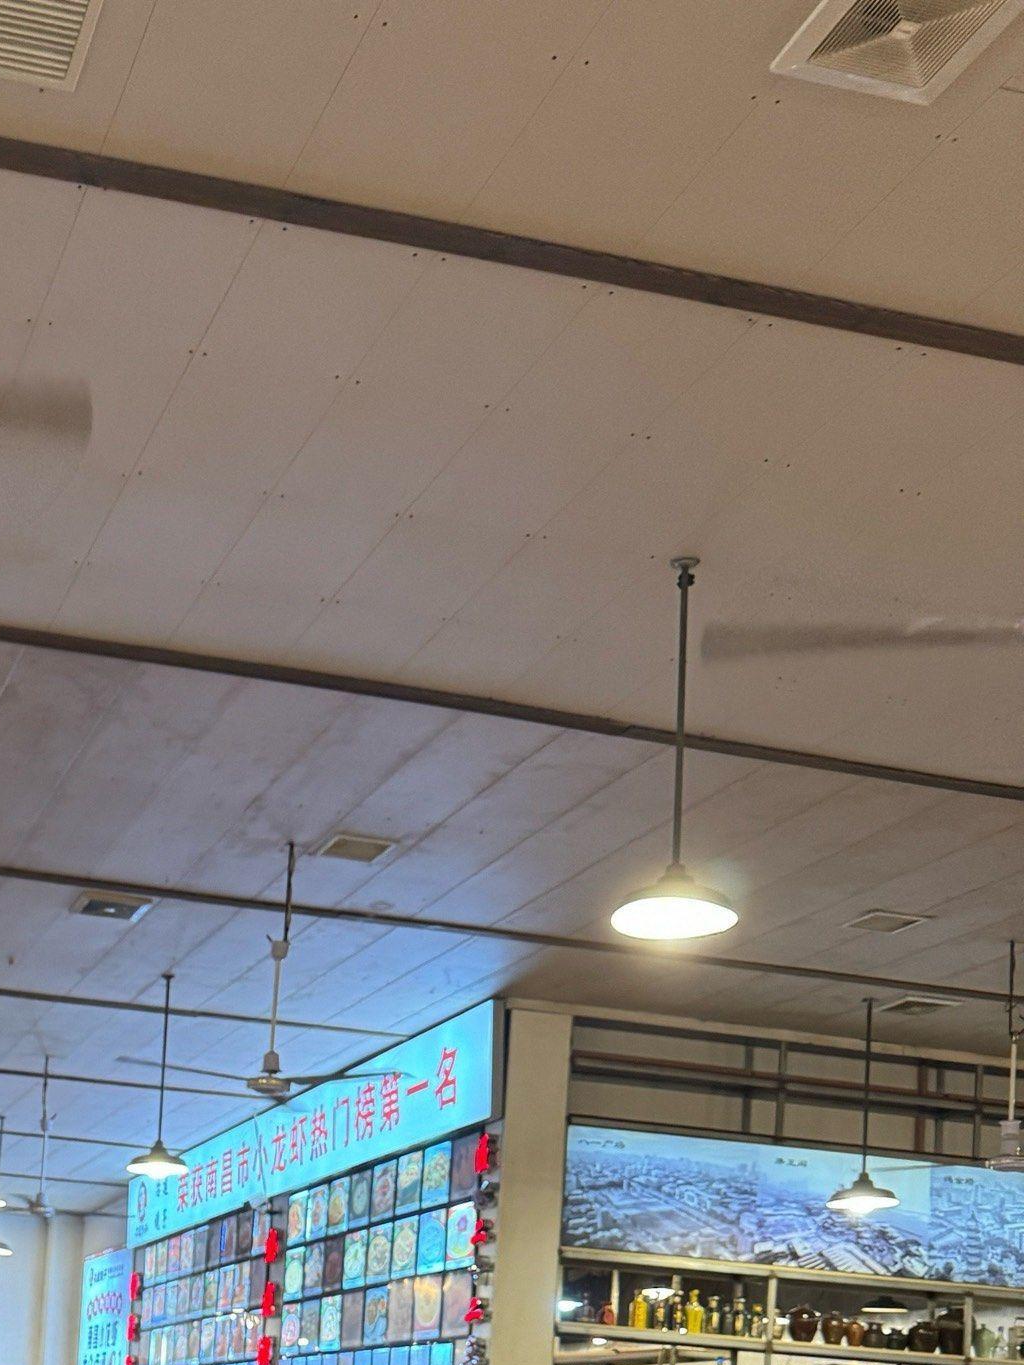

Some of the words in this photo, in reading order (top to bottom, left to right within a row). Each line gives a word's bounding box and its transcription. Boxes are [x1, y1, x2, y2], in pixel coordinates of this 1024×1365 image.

[176, 1047, 458, 1213] 荣获南昌市小龙虾热门榜第一名
